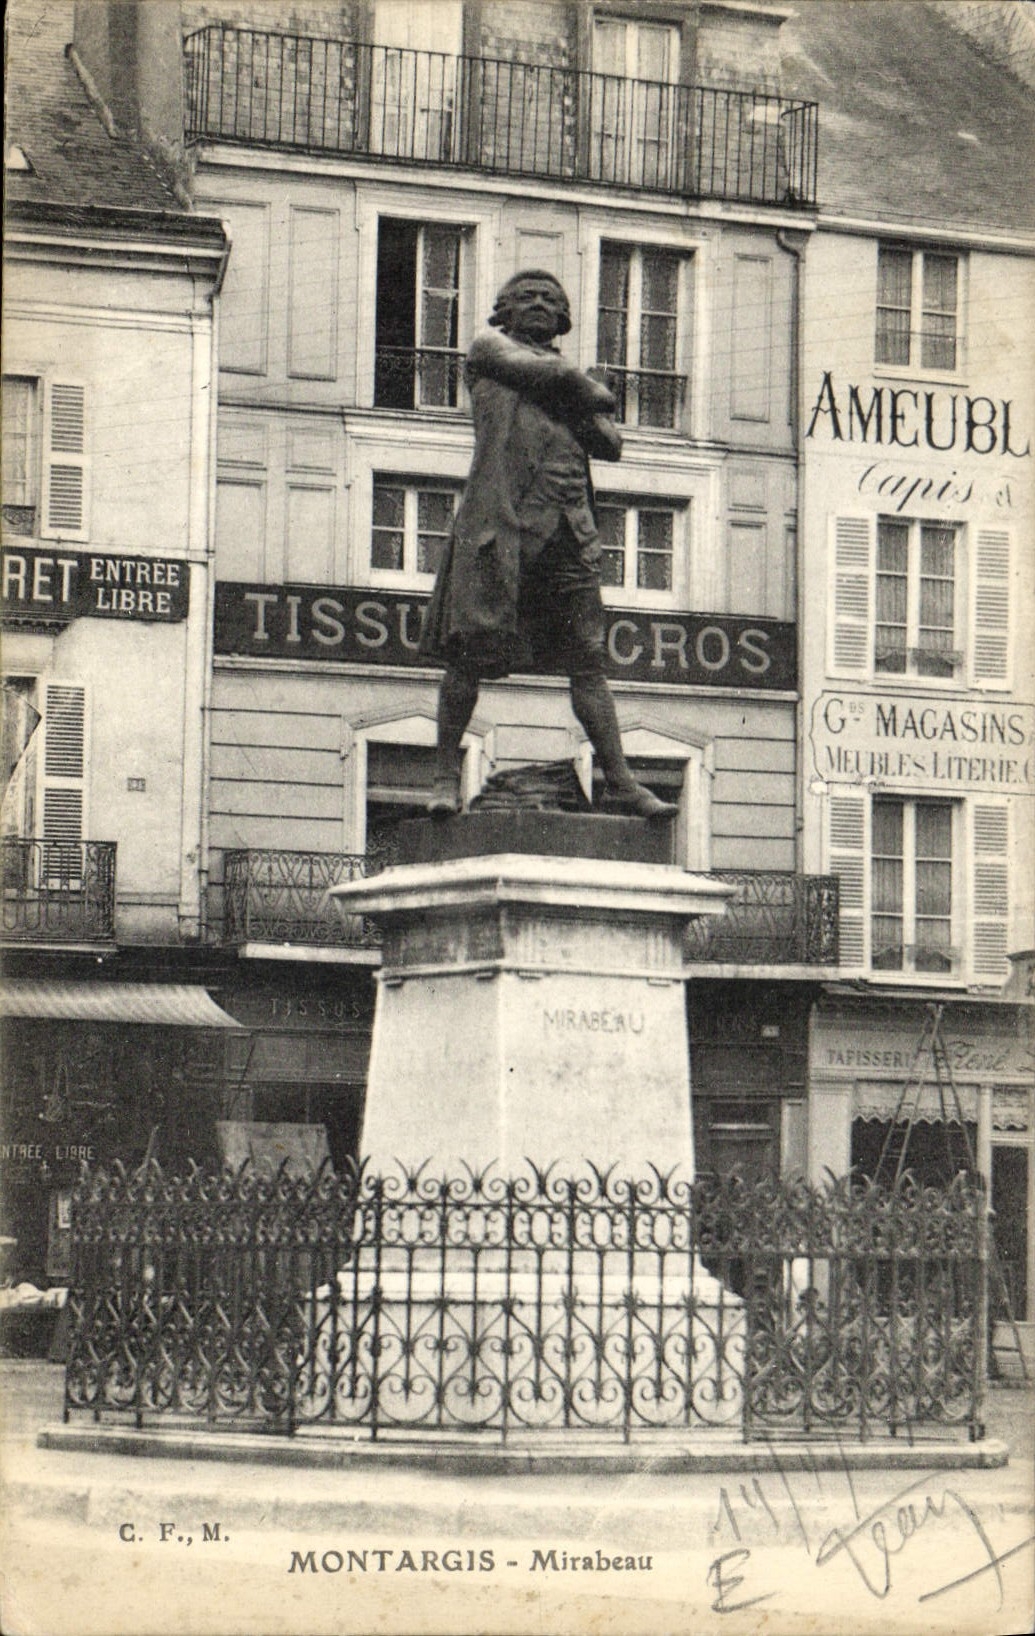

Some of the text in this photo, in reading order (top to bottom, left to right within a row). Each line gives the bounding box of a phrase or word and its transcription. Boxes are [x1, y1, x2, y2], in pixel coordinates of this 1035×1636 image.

[805, 370, 1030, 457] AMEUBL
[2, 554, 78, 602] RET
[89, 557, 181, 586] ENTRÉE
[95, 587, 171, 613] LIBRE
[607, 619, 772, 674] GROS
[875, 703, 1025, 746] MAGASINS
[543, 1008, 646, 1036] MIRABEAU
[55, 1144, 97, 1161] LIBRE
